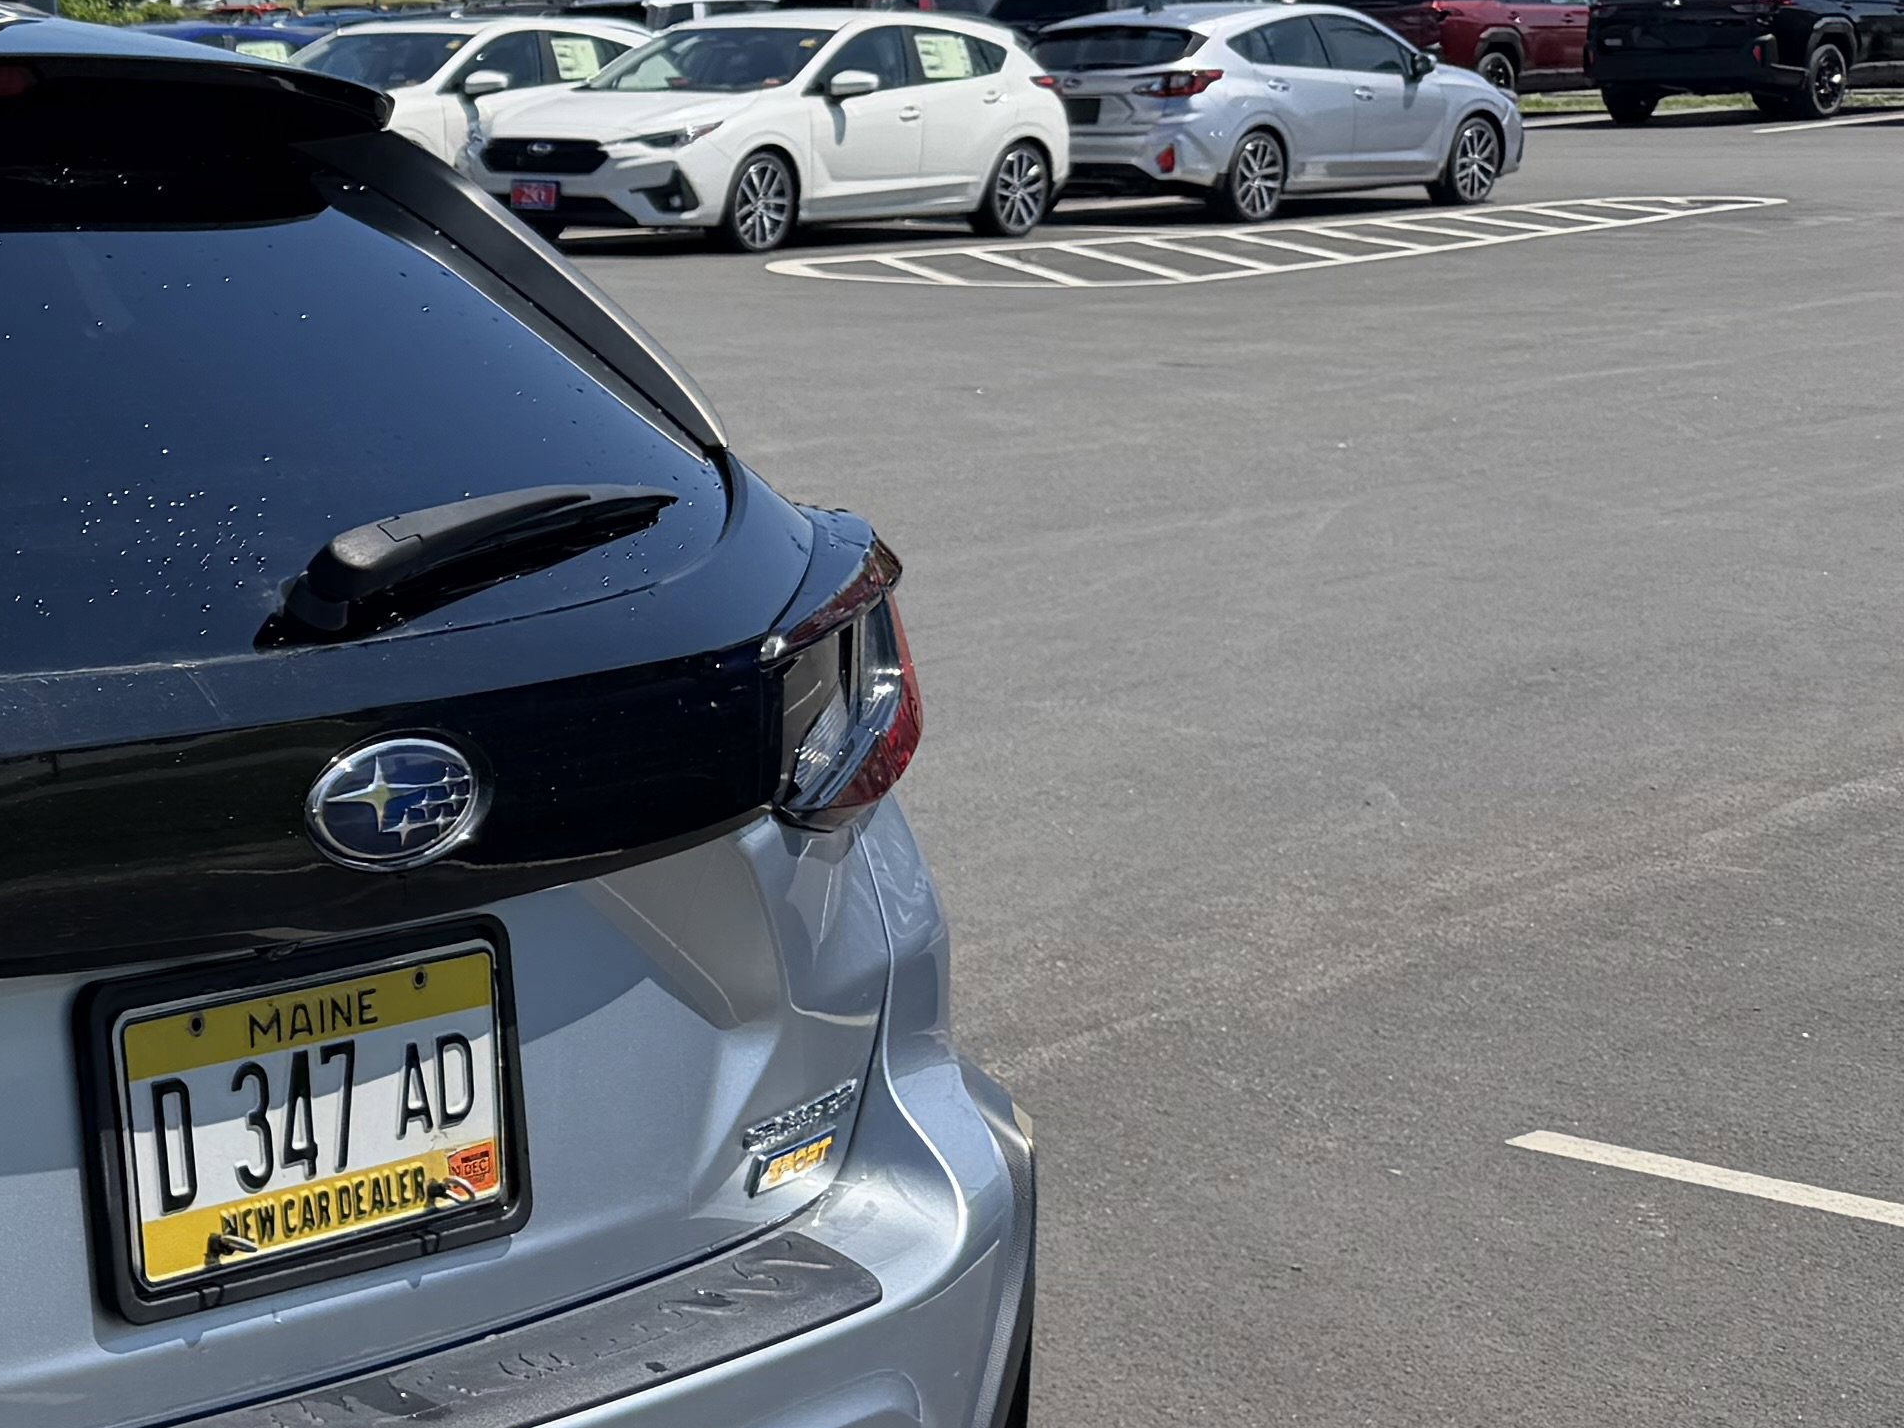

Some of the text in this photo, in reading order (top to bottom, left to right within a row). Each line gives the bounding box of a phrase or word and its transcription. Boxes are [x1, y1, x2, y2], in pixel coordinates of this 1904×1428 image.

[247, 987, 379, 1049] MAINE
[150, 1032, 475, 1217] D 347 AD
[220, 1162, 425, 1245] NEW CAR DEALER
